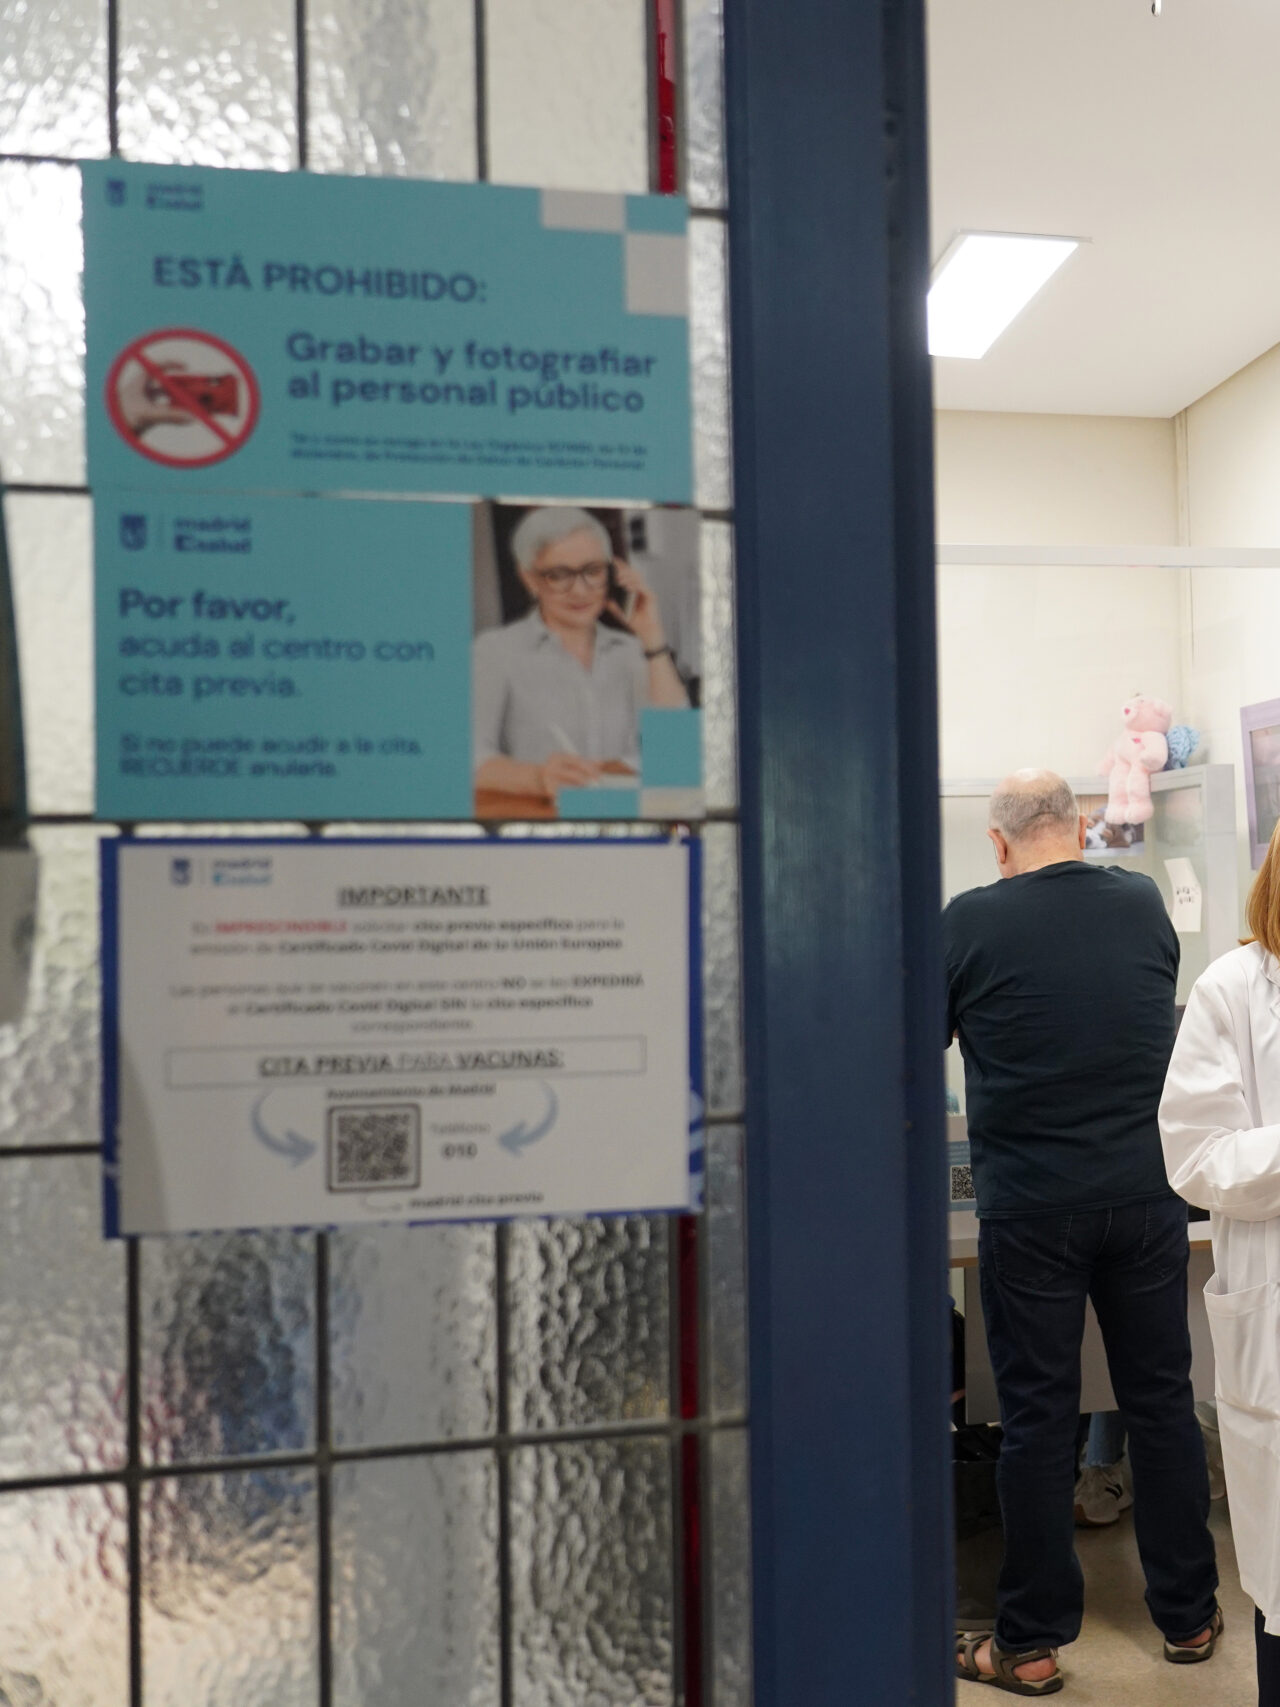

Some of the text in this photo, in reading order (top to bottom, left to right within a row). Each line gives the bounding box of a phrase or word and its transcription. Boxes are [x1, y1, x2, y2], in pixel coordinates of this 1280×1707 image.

[153, 253, 487, 304] ESTÁ PROHIBIDO:
[286, 330, 656, 381] Grabar y fotografiar
[287, 369, 645, 414] al personal público
[119, 587, 296, 626] Por favor,
[119, 631, 435, 662] acuda al centro con
[119, 671, 303, 701] cita previa.
[181, 736, 254, 756] puede
[338, 885, 490, 907] IMPORTANTE
[258, 1050, 565, 1079] CITA PREVIA PARA VACUNAS:
[441, 1142, 478, 1160] 010
